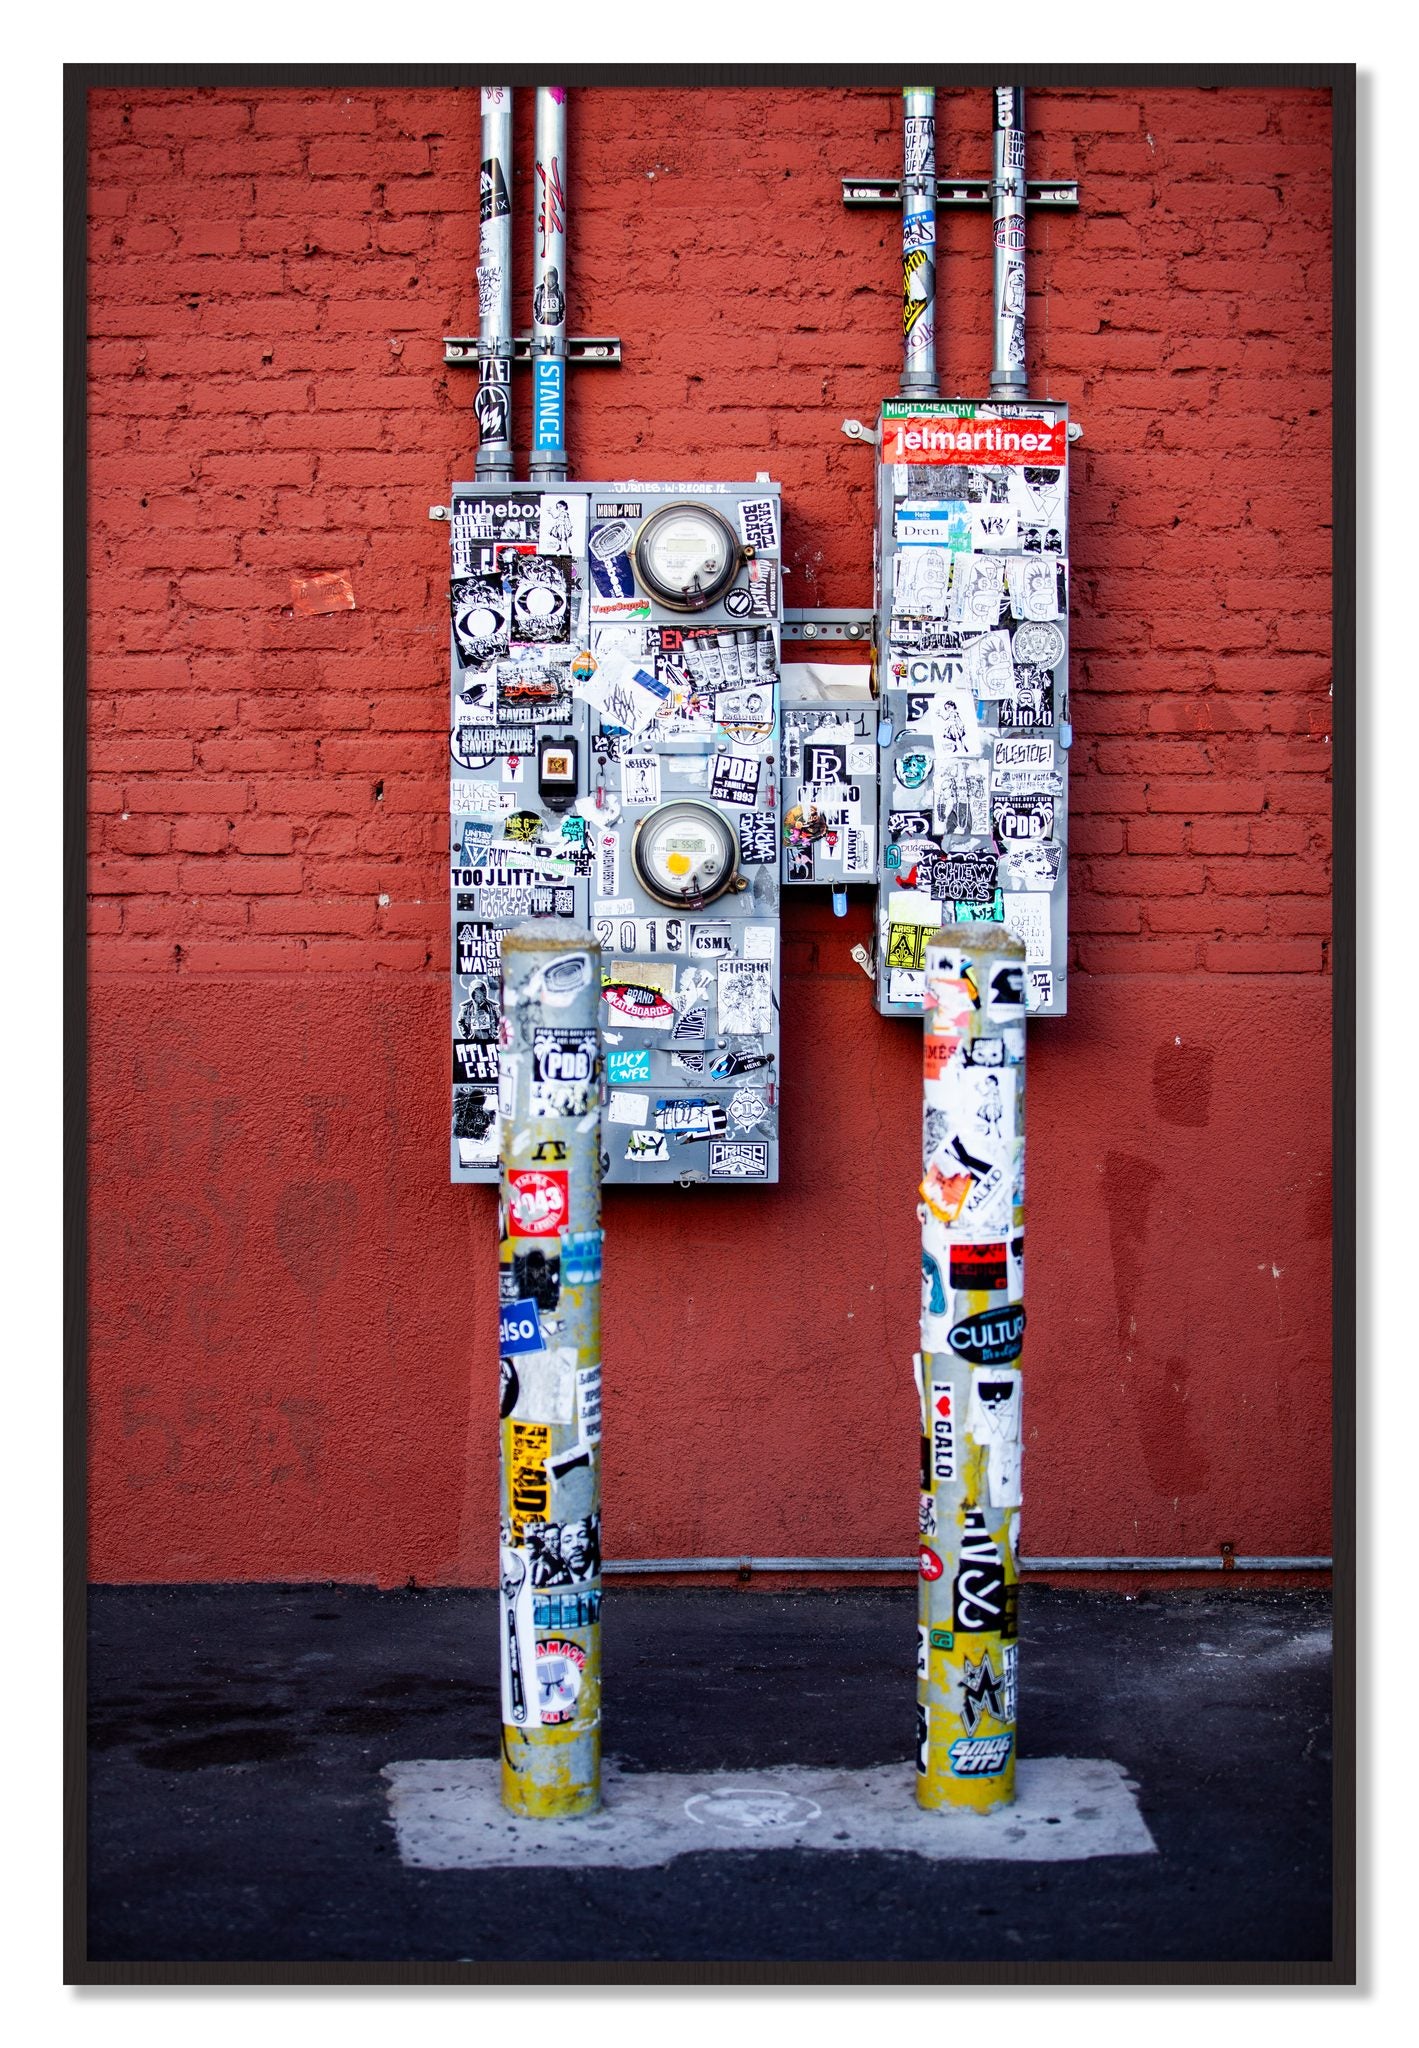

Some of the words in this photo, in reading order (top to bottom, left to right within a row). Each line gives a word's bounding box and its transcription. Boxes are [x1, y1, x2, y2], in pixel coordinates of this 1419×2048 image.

[540, 364, 561, 445] STANCE
[896, 426, 1054, 456] jelmartinez
[742, 504, 763, 549] BOAST
[904, 526, 944, 536] Dren.
[716, 756, 760, 783] PDB
[724, 780, 746, 790] FAMILY
[712, 788, 729, 799] EST.
[732, 790, 754, 803] 1993
[1006, 815, 1042, 837] PDB
[933, 862, 995, 882] CHEW
[935, 881, 990, 900] TOYS
[597, 920, 683, 953] 2019
[893, 925, 916, 934] ARISE
[696, 937, 733, 953] CSMK
[548, 1052, 588, 1079] PDB
[744, 1061, 761, 1070] HERE
[713, 1145, 764, 1164] ARISE
[935, 1420, 953, 1478] GALO
[955, 1753, 1004, 1771] CITY
